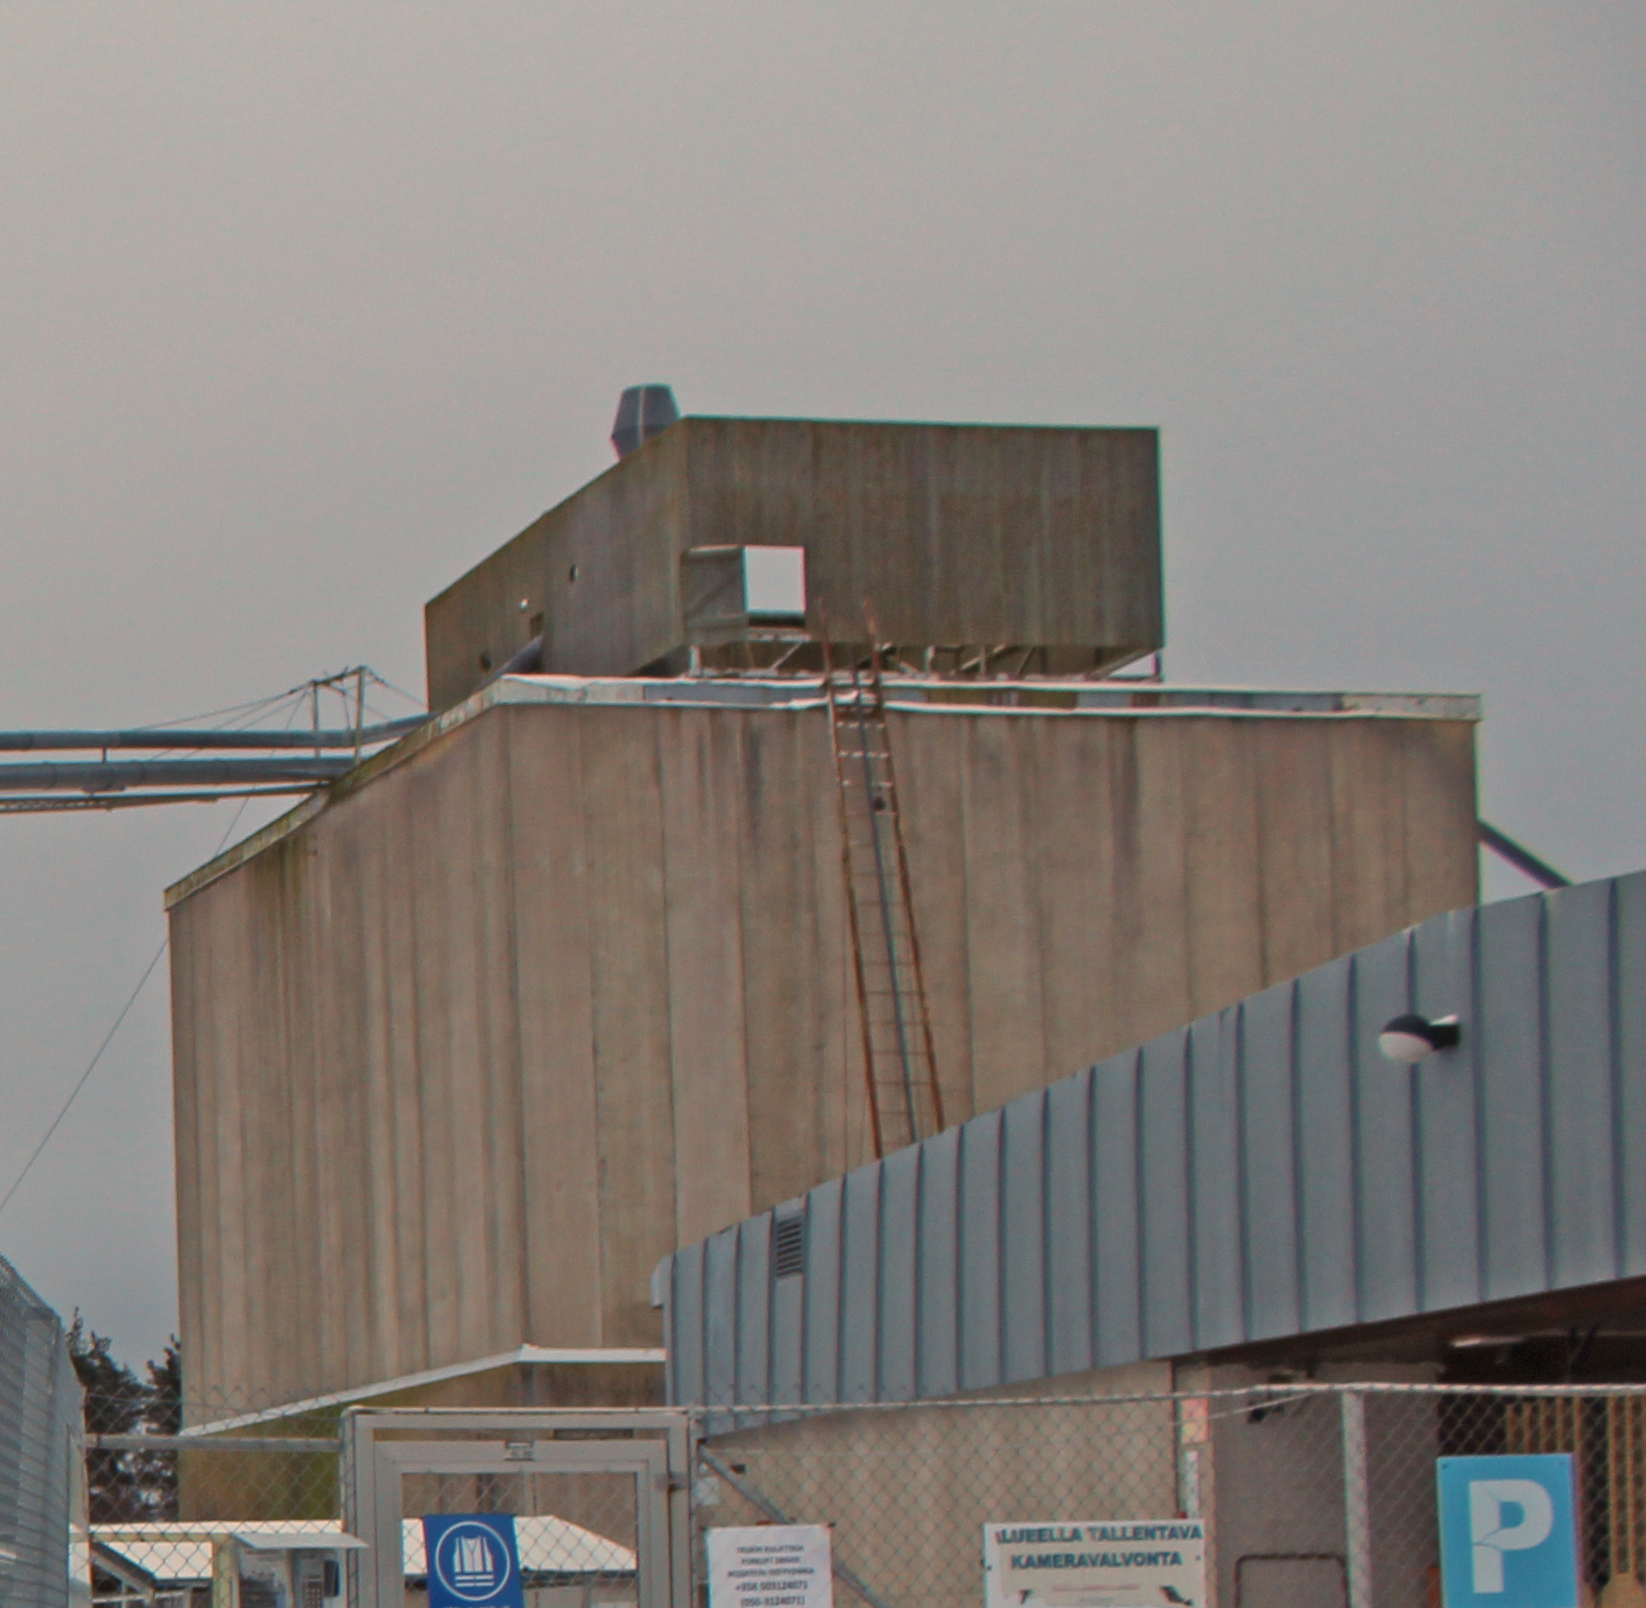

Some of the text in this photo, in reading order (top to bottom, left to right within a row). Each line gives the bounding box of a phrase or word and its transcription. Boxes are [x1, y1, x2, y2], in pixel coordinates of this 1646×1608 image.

[996, 1525, 1203, 1543] LUEELLA TALLENTAVA
[1469, 1478, 1554, 1594] P
[1011, 1551, 1183, 1569] KAMERAVALVONTA
